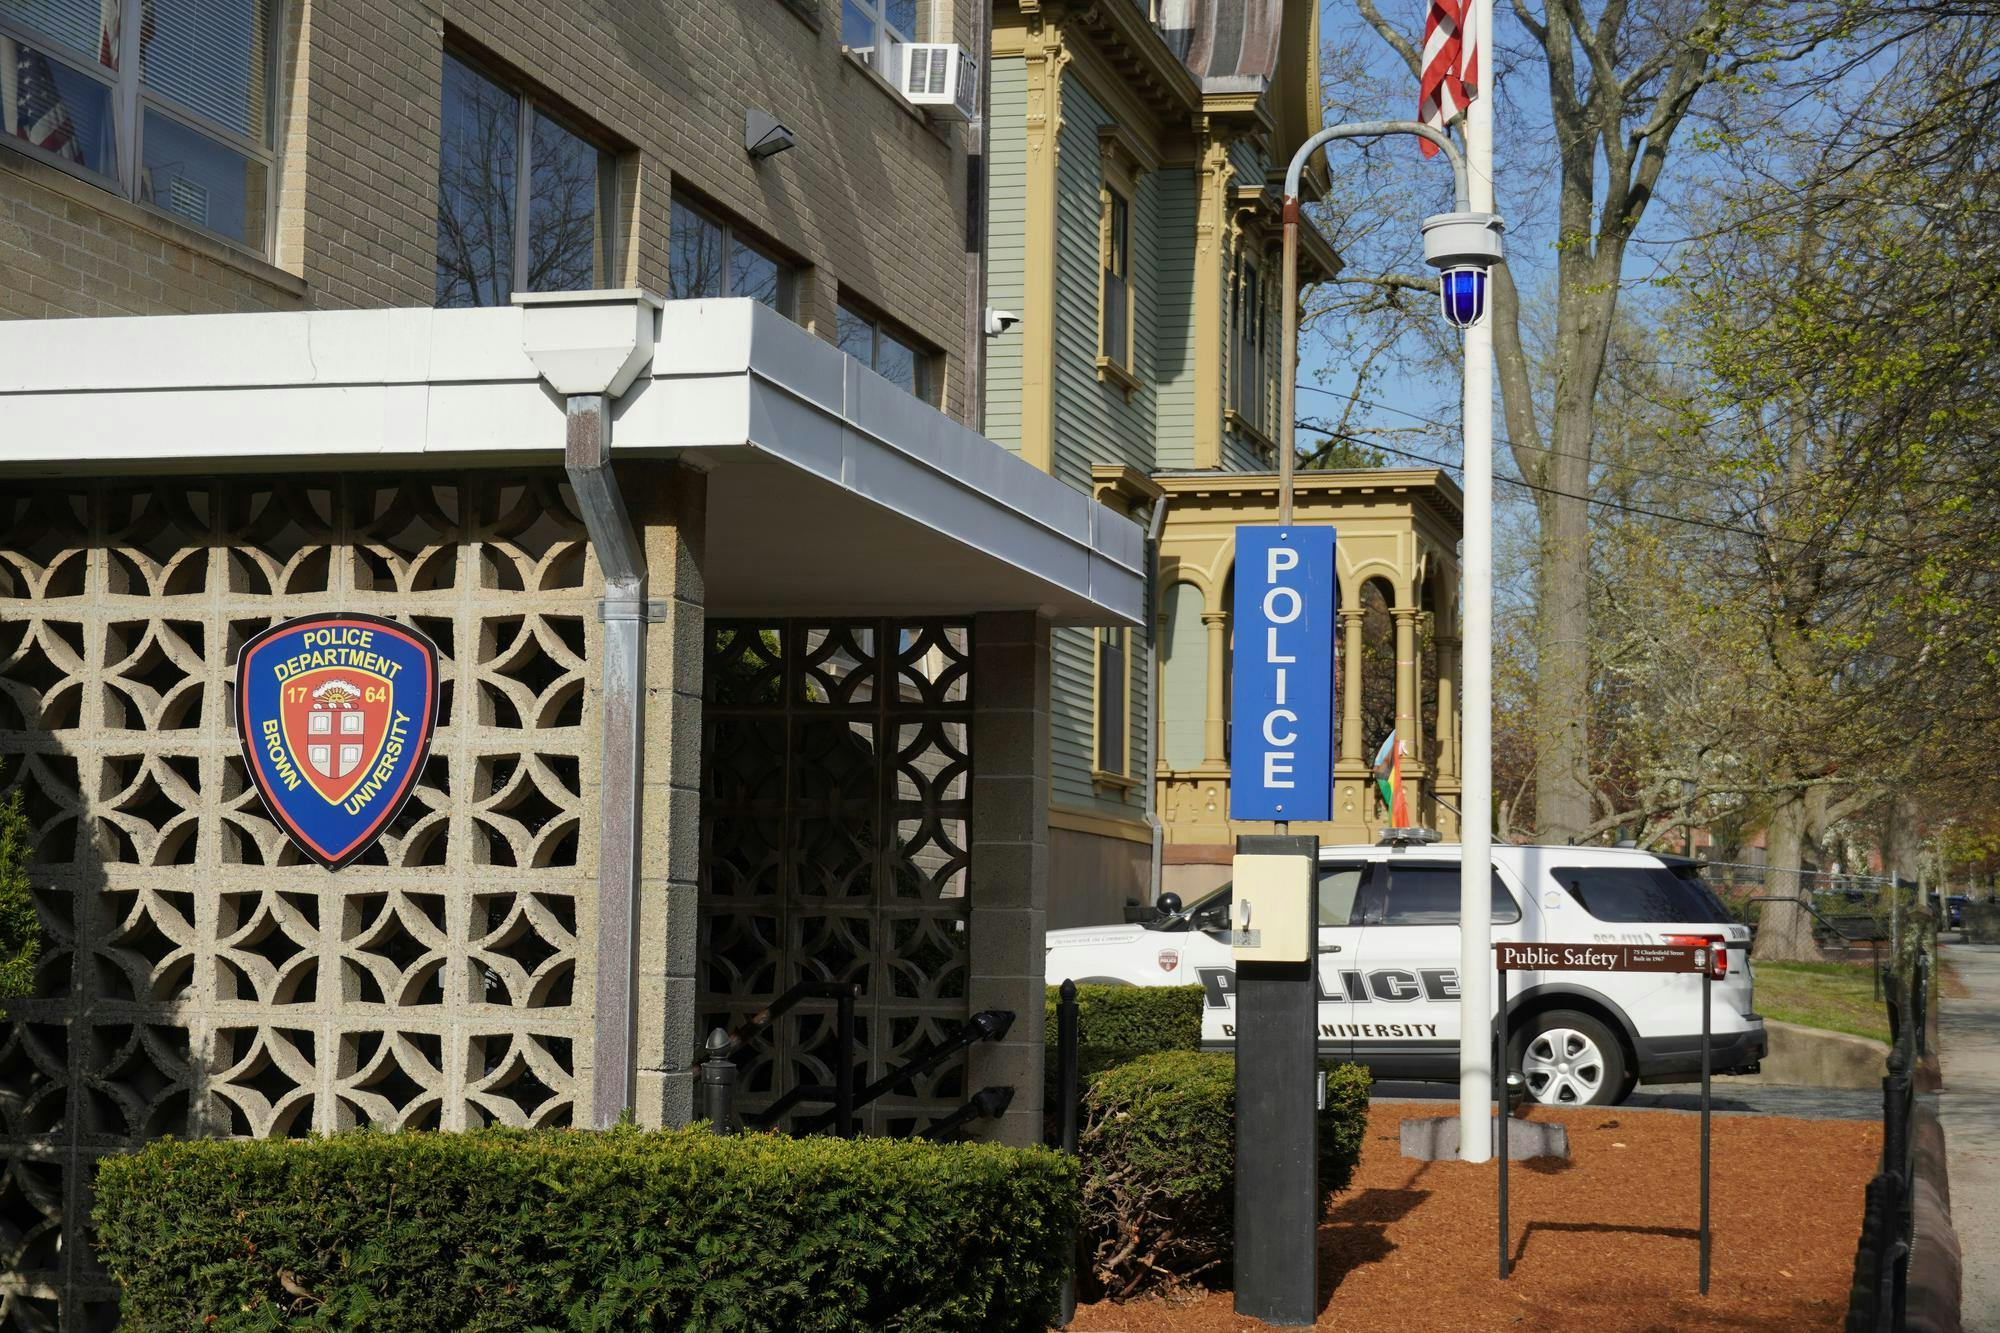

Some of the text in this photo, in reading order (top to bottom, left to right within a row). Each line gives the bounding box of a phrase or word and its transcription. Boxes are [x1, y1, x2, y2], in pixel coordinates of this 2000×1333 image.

[303, 628, 374, 649] POLICE
[273, 648, 403, 683] DEPARTMENT
[1262, 547, 1302, 788] POLICE
[287, 686, 387, 704] 17 64
[262, 718, 302, 792] BROWN
[343, 710, 411, 816] UNIVERSITY
[1504, 947, 1618, 970] Public Safety
[1194, 965, 1461, 1009] PLICE
[1317, 1024, 1437, 1037] NIVERSITY
